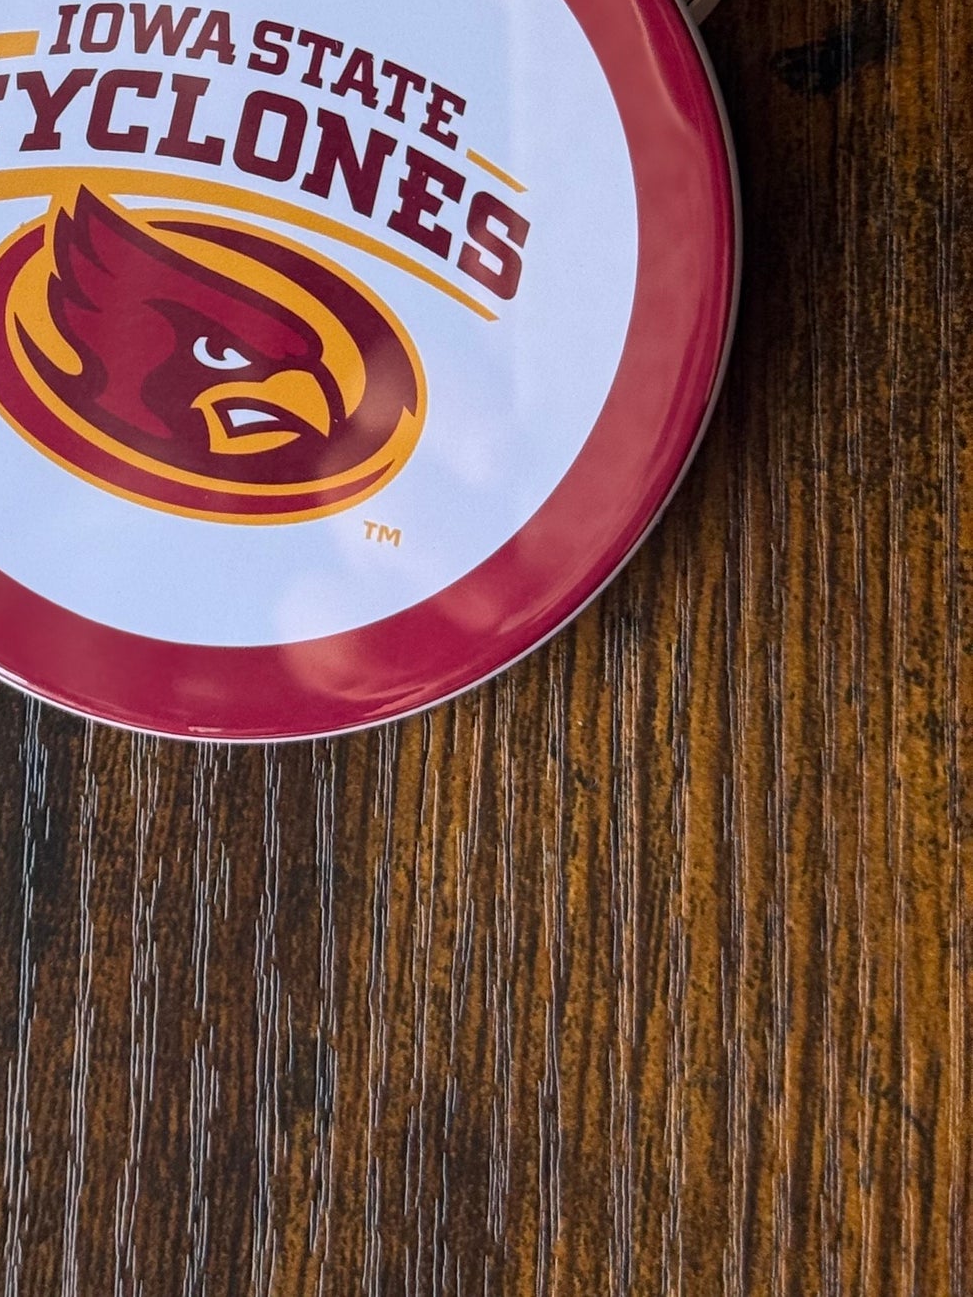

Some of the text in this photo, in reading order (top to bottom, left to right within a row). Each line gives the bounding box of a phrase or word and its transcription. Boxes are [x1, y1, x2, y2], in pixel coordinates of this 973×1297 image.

[48, 2, 467, 151] IOWA STATE
[363, 519, 402, 548] TM
